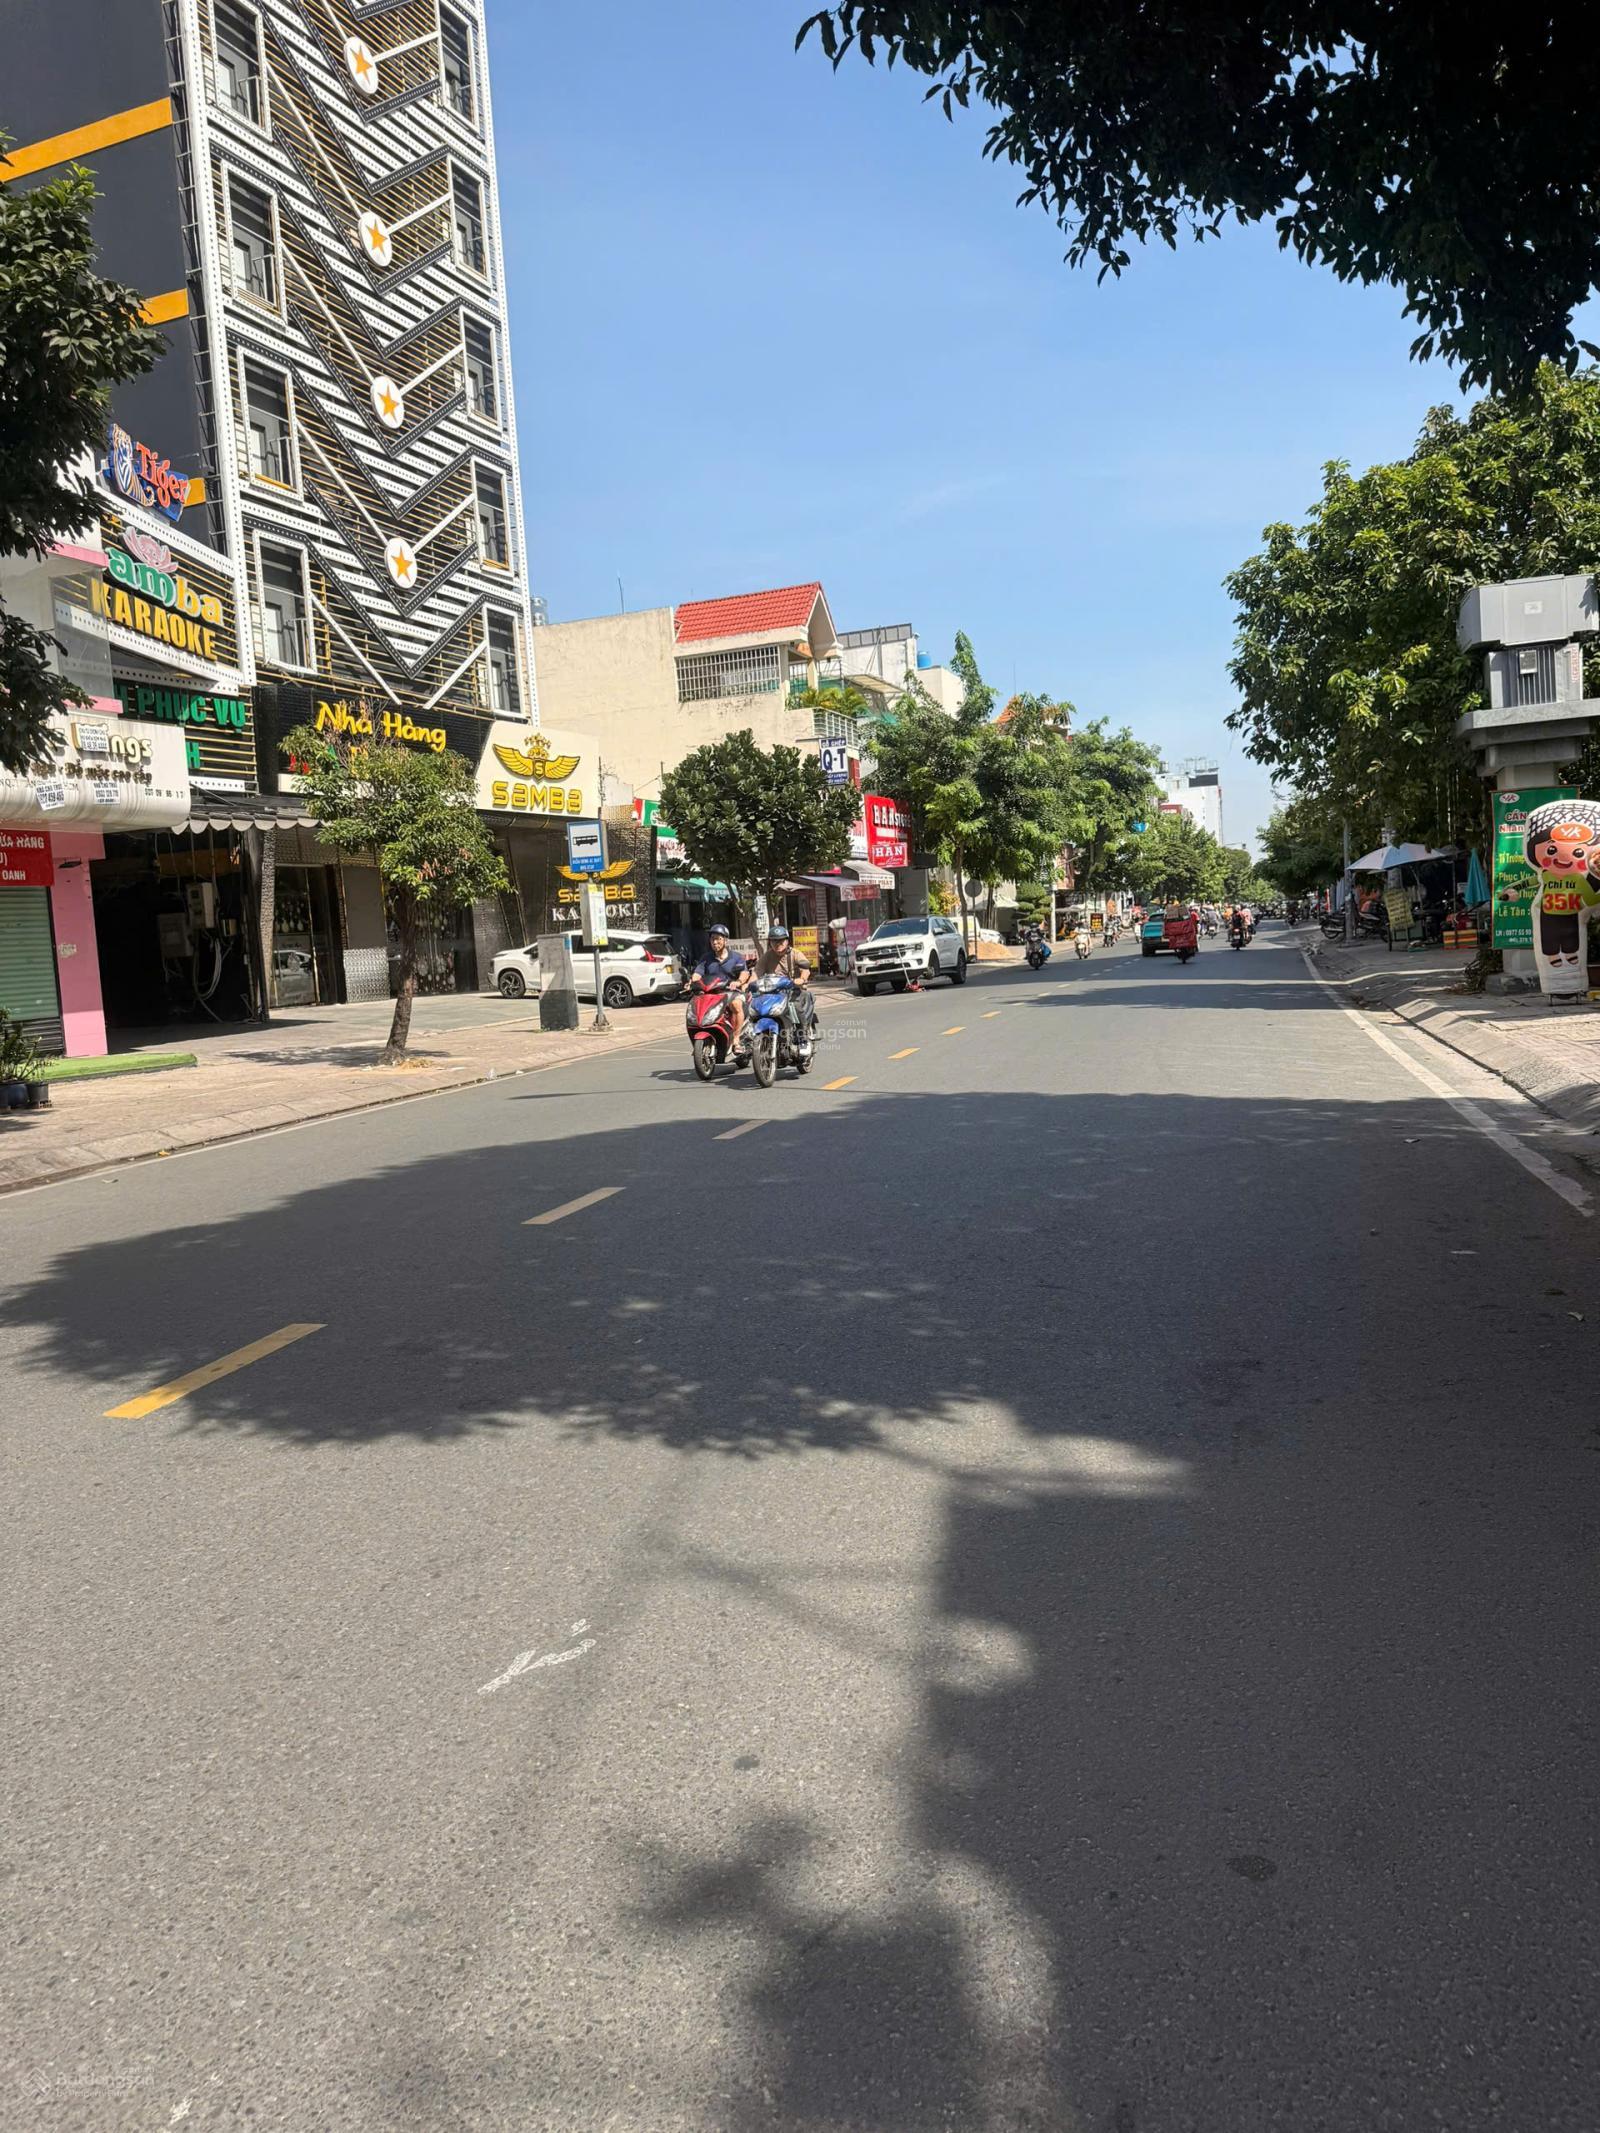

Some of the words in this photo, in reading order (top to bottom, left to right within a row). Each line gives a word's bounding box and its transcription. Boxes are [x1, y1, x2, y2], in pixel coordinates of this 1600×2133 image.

[136, 441, 188, 508] Tiger
[104, 547, 224, 626] amba
[91, 578, 218, 661] KARAOKE
[212, 697, 246, 733] VỤ
[382, 711, 446, 752] Hàng
[16, 834, 45, 848] HÀNG
[552, 902, 641, 921] KAOKE
[1543, 893, 1581, 911] 35K
